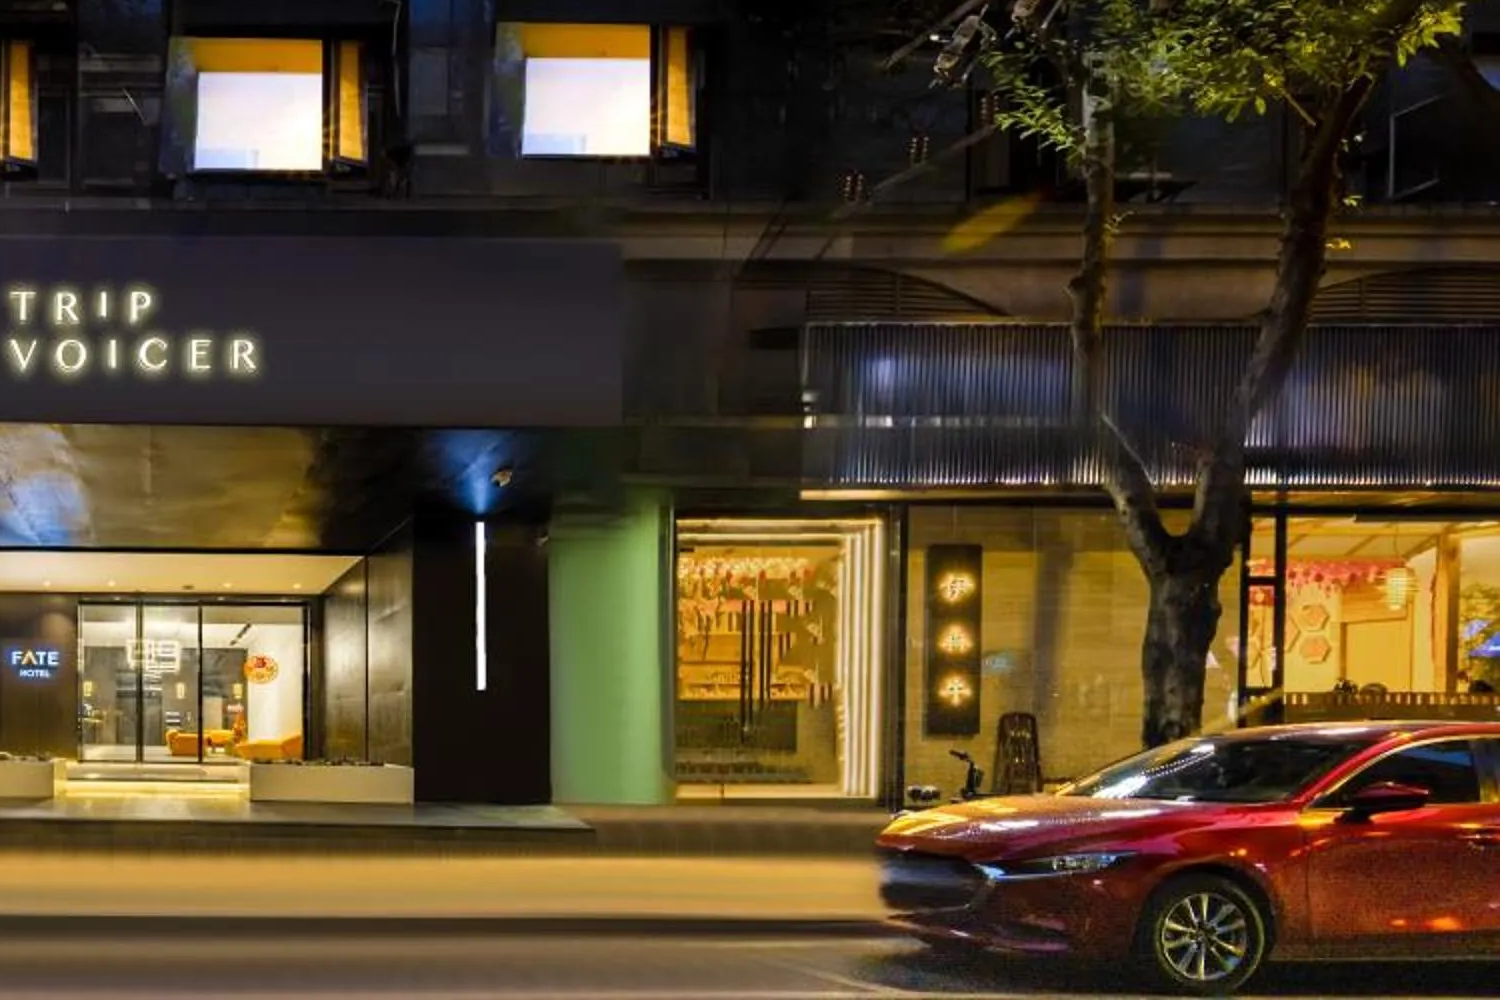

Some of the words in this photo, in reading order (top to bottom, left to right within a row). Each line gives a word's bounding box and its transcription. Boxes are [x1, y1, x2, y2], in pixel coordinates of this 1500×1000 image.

[10, 291, 153, 324] TRIP
[10, 338, 258, 371] VOICER
[11, 648, 60, 665] FATE
[19, 669, 50, 677] HOTEL
